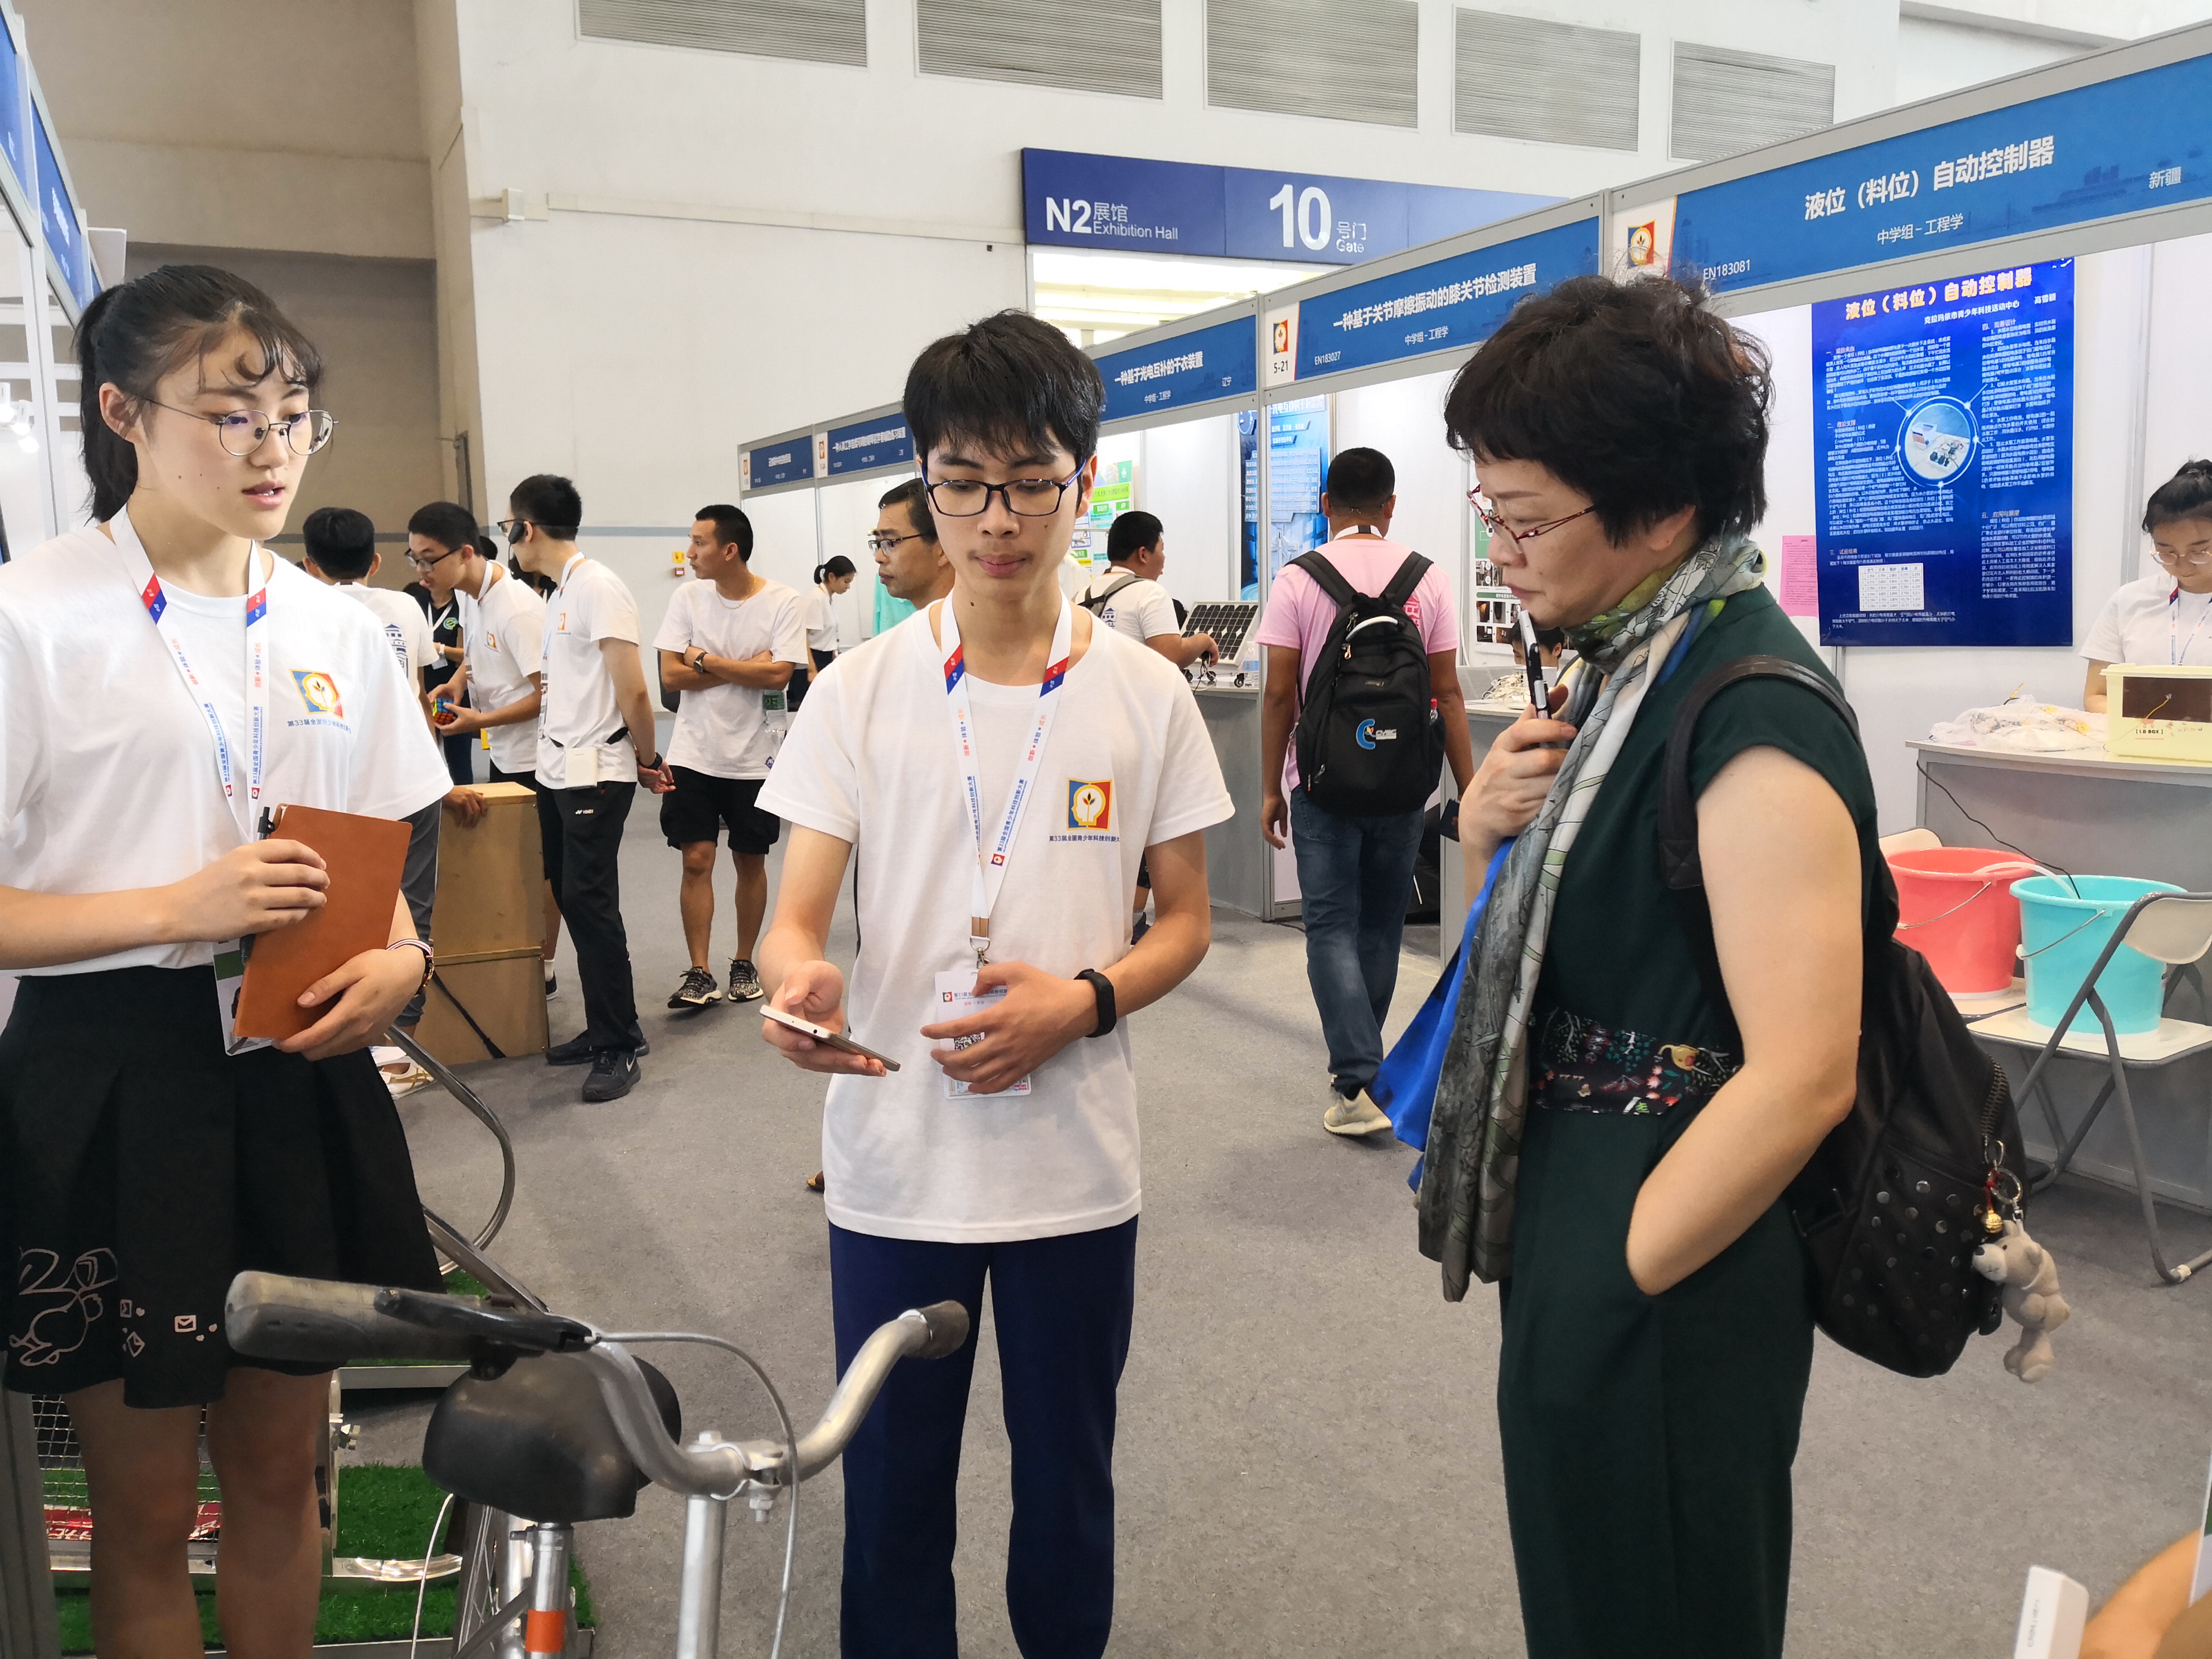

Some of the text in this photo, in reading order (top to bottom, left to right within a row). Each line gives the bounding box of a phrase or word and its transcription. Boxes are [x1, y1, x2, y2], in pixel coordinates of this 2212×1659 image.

[1804, 135, 2055, 221] 液位（料位）自动控制器
[2148, 166, 2182, 191] 新疆
[1046, 197, 1128, 233] N2 展馆
[1269, 184, 1332, 250] 10
[1093, 221, 1178, 240] Exhibition Hall
[1337, 221, 1367, 240] 号门
[1336, 240, 1364, 253] Gate
[1702, 259, 1752, 282] EN183081
[1333, 263, 1537, 331] 一种基于关节摩擦振动的膝关节检测装置
[1846, 267, 2032, 320] 液位（料位）自动控制器
[1114, 351, 1204, 386] 一种基于光电互补的干衣装置
[1274, 360, 1288, 373] 5-21
[1314, 351, 1341, 365] EN183027
[952, 672, 957, 681] 中国
[997, 778, 1025, 852] 第33届全国青少年科技创新大赛
